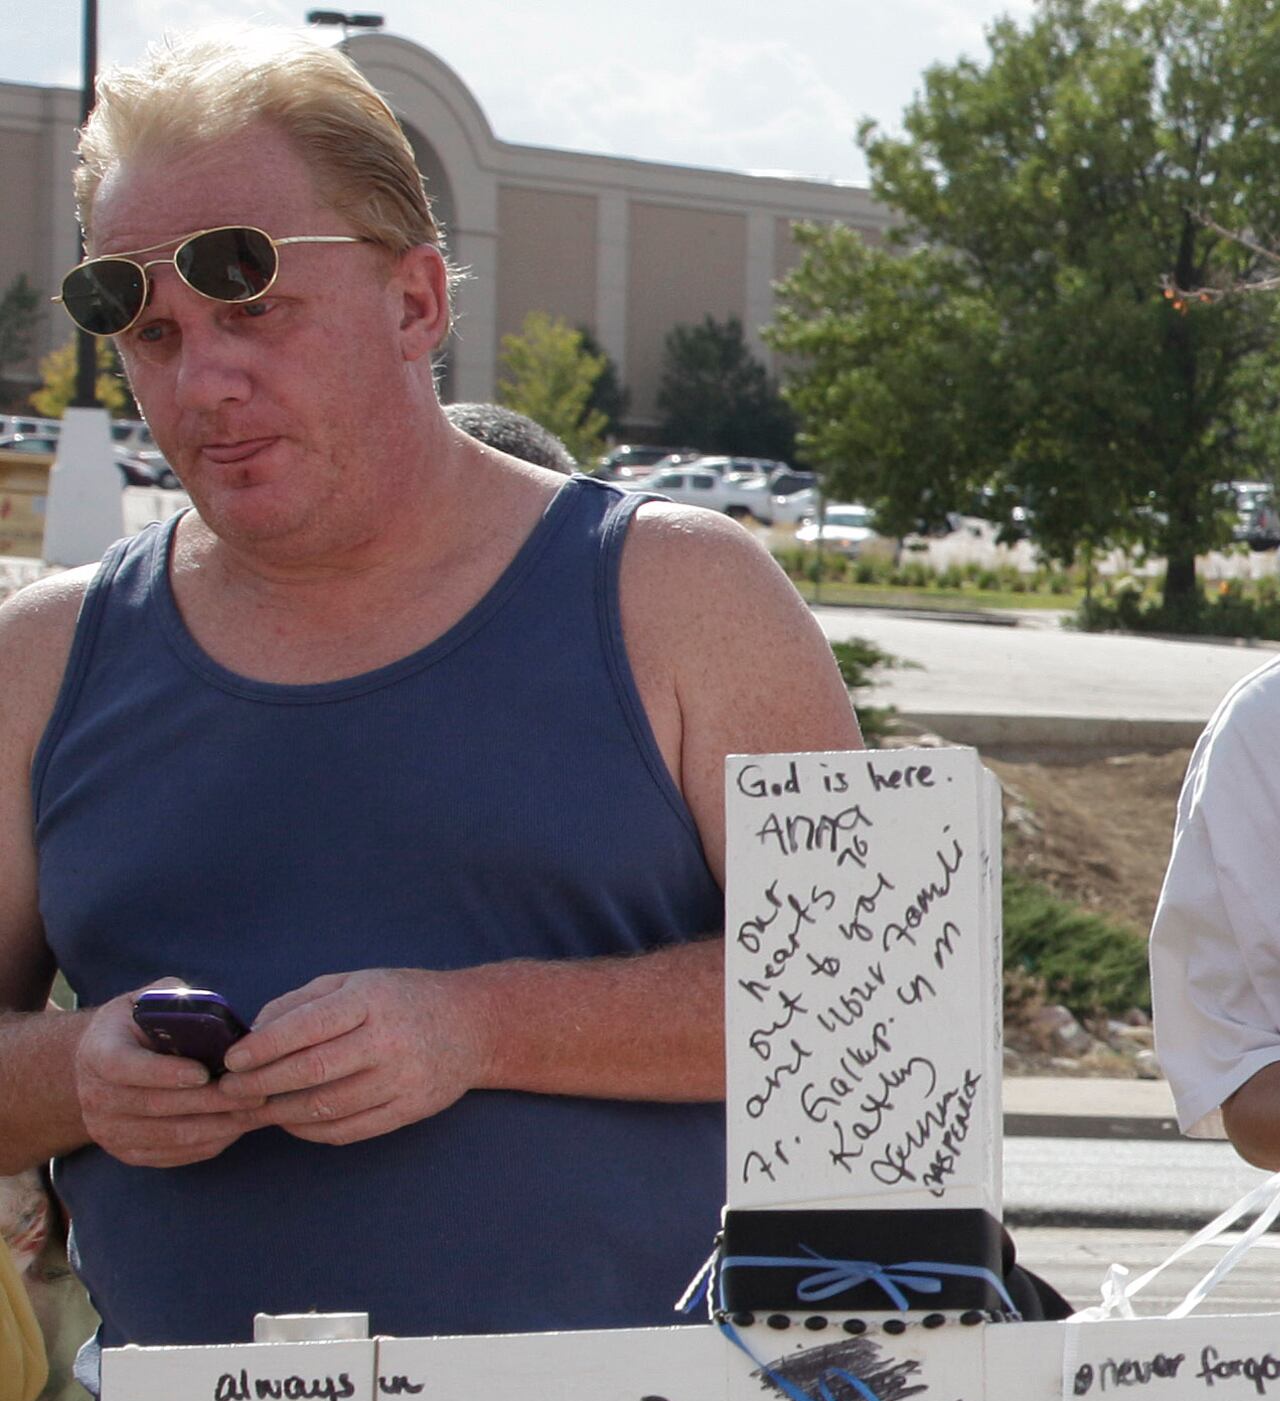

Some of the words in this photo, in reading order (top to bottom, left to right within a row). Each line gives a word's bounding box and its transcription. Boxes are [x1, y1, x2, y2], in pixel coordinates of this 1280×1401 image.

[737, 761, 800, 797] God
[820, 763, 849, 792] is
[738, 884, 836, 1002] hearts
[749, 989, 808, 1061] out
[746, 1038, 813, 1119] and
